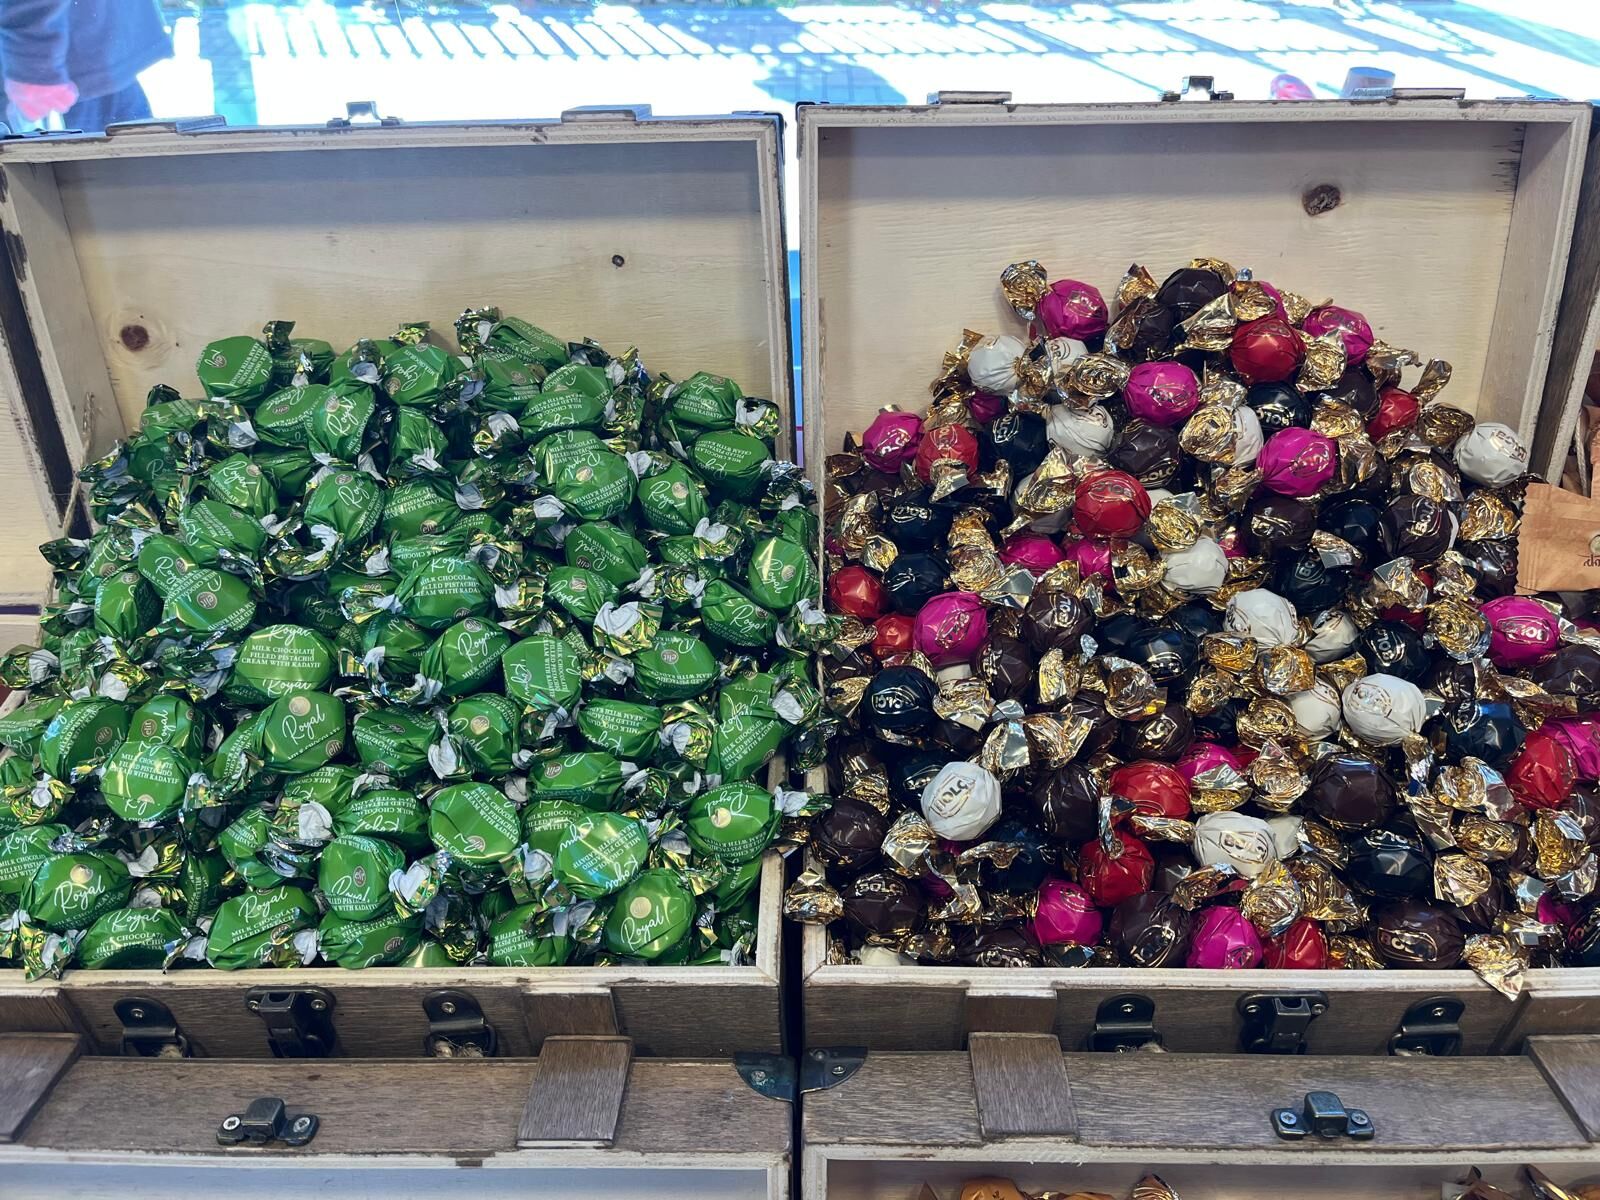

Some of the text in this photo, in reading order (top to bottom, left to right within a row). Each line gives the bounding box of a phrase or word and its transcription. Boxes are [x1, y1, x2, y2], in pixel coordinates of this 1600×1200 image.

[198, 594, 216, 608] elit
[143, 720, 154, 737] elit
[281, 704, 327, 745] Royal
[54, 874, 107, 915] Royal
[238, 884, 288, 923] Royal
[107, 908, 161, 933] Royal
[621, 905, 664, 952] Royal
